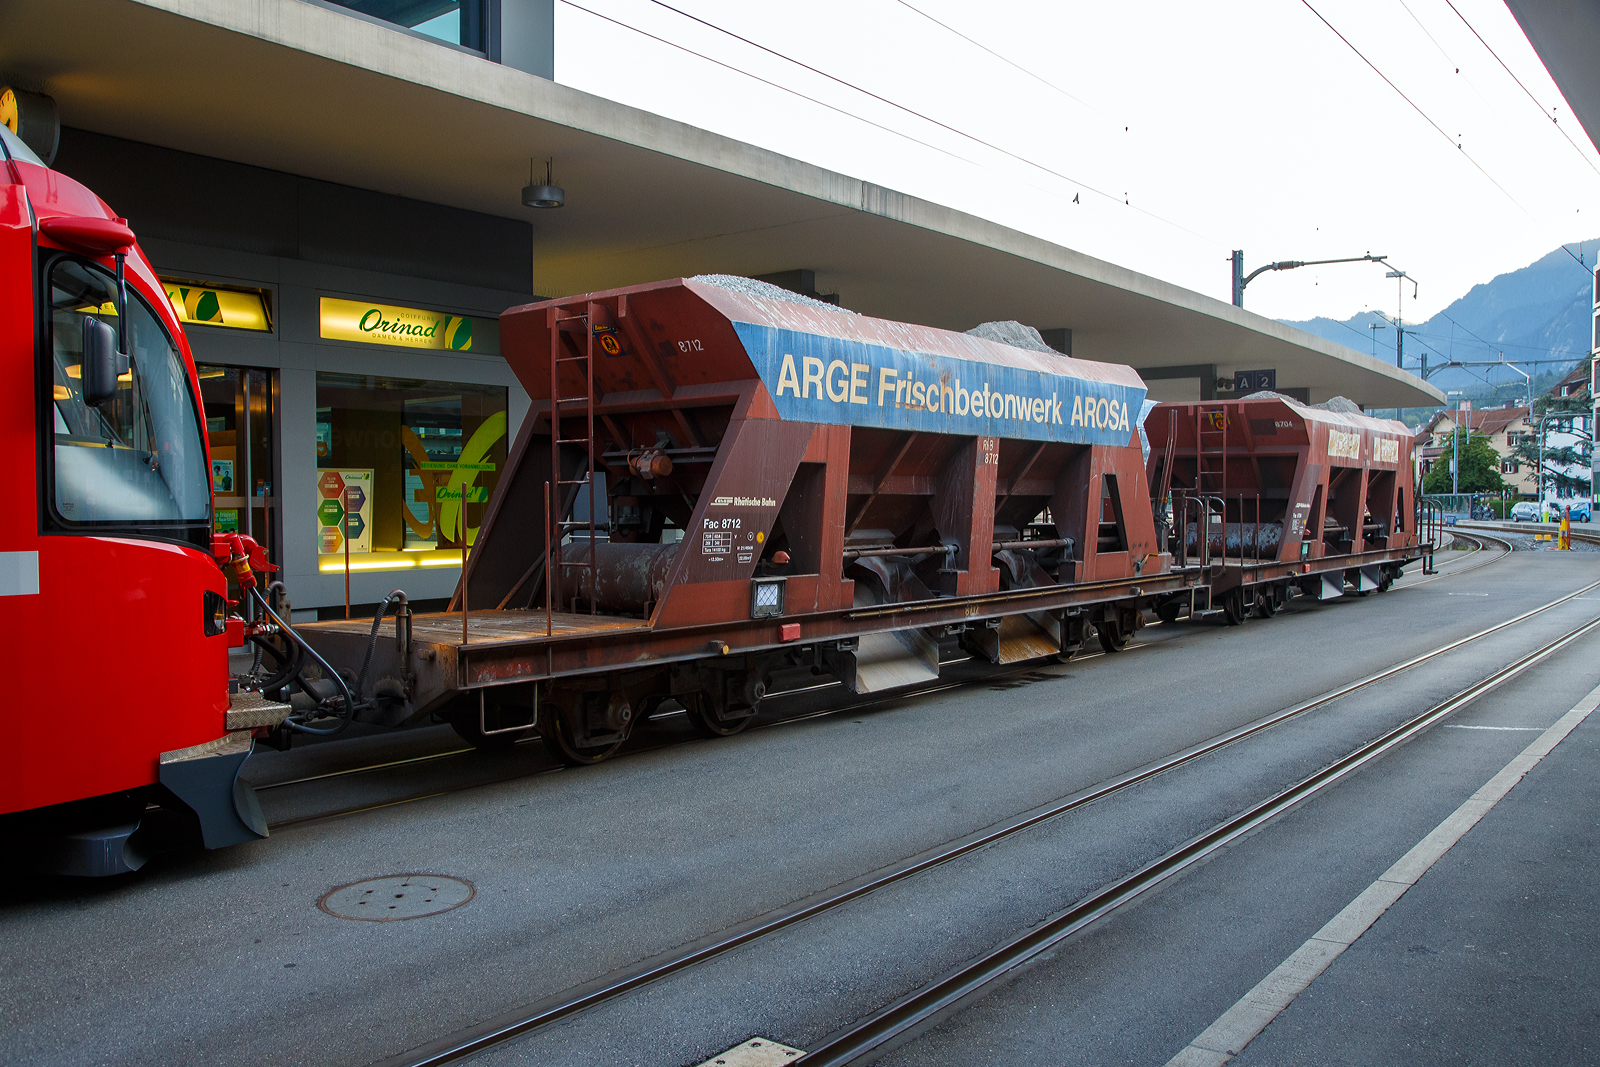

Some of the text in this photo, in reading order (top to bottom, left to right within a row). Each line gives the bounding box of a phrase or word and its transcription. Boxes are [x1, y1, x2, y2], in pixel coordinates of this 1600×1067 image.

[401, 312, 434, 321] COIFFURE
[359, 308, 440, 338] Orinad
[372, 332, 396, 341] DAMEN
[405, 336, 433, 344] HERREN
[678, 339, 704, 353] 8712
[1240, 376, 1269, 388] A 2
[776, 353, 1130, 432] ARGE Frischbetonwerk AROSA
[985, 452, 999, 465] 8712
[437, 487, 474, 499] Orind
[734, 497, 776, 507] Rhätische Bahn
[703, 518, 741, 529] Fac 8712
